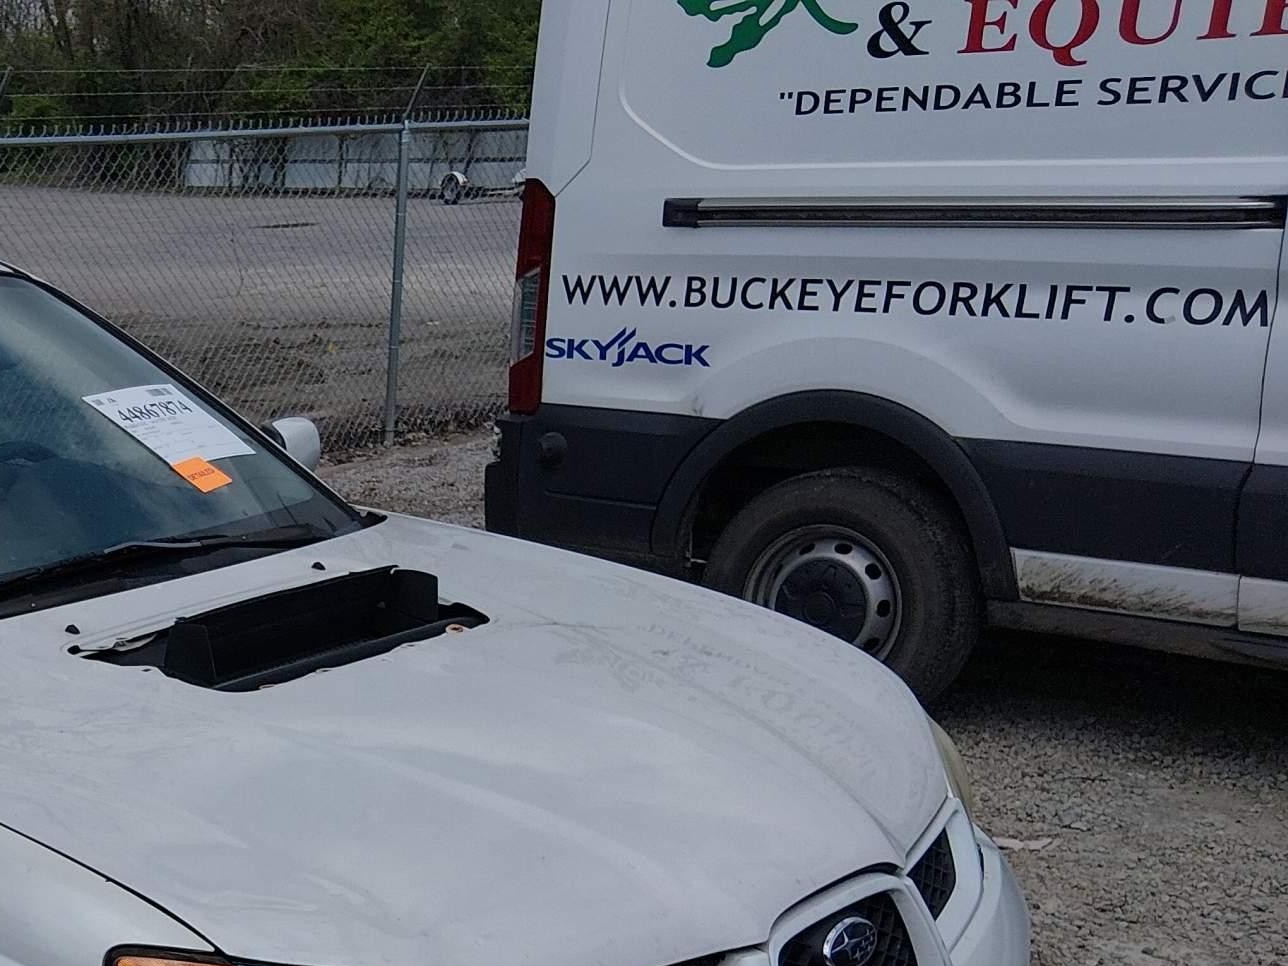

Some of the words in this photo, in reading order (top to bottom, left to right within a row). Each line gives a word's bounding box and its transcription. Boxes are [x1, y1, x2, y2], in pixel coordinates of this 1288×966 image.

[866, 1, 933, 59] &
[780, 79, 1083, 117] "DEPENDABLE
[1096, 70, 1288, 106] SERVIC
[562, 274, 1269, 327] WWW.BUCKEYEFORKLIFT.COM
[117, 400, 193, 423] 44867874
